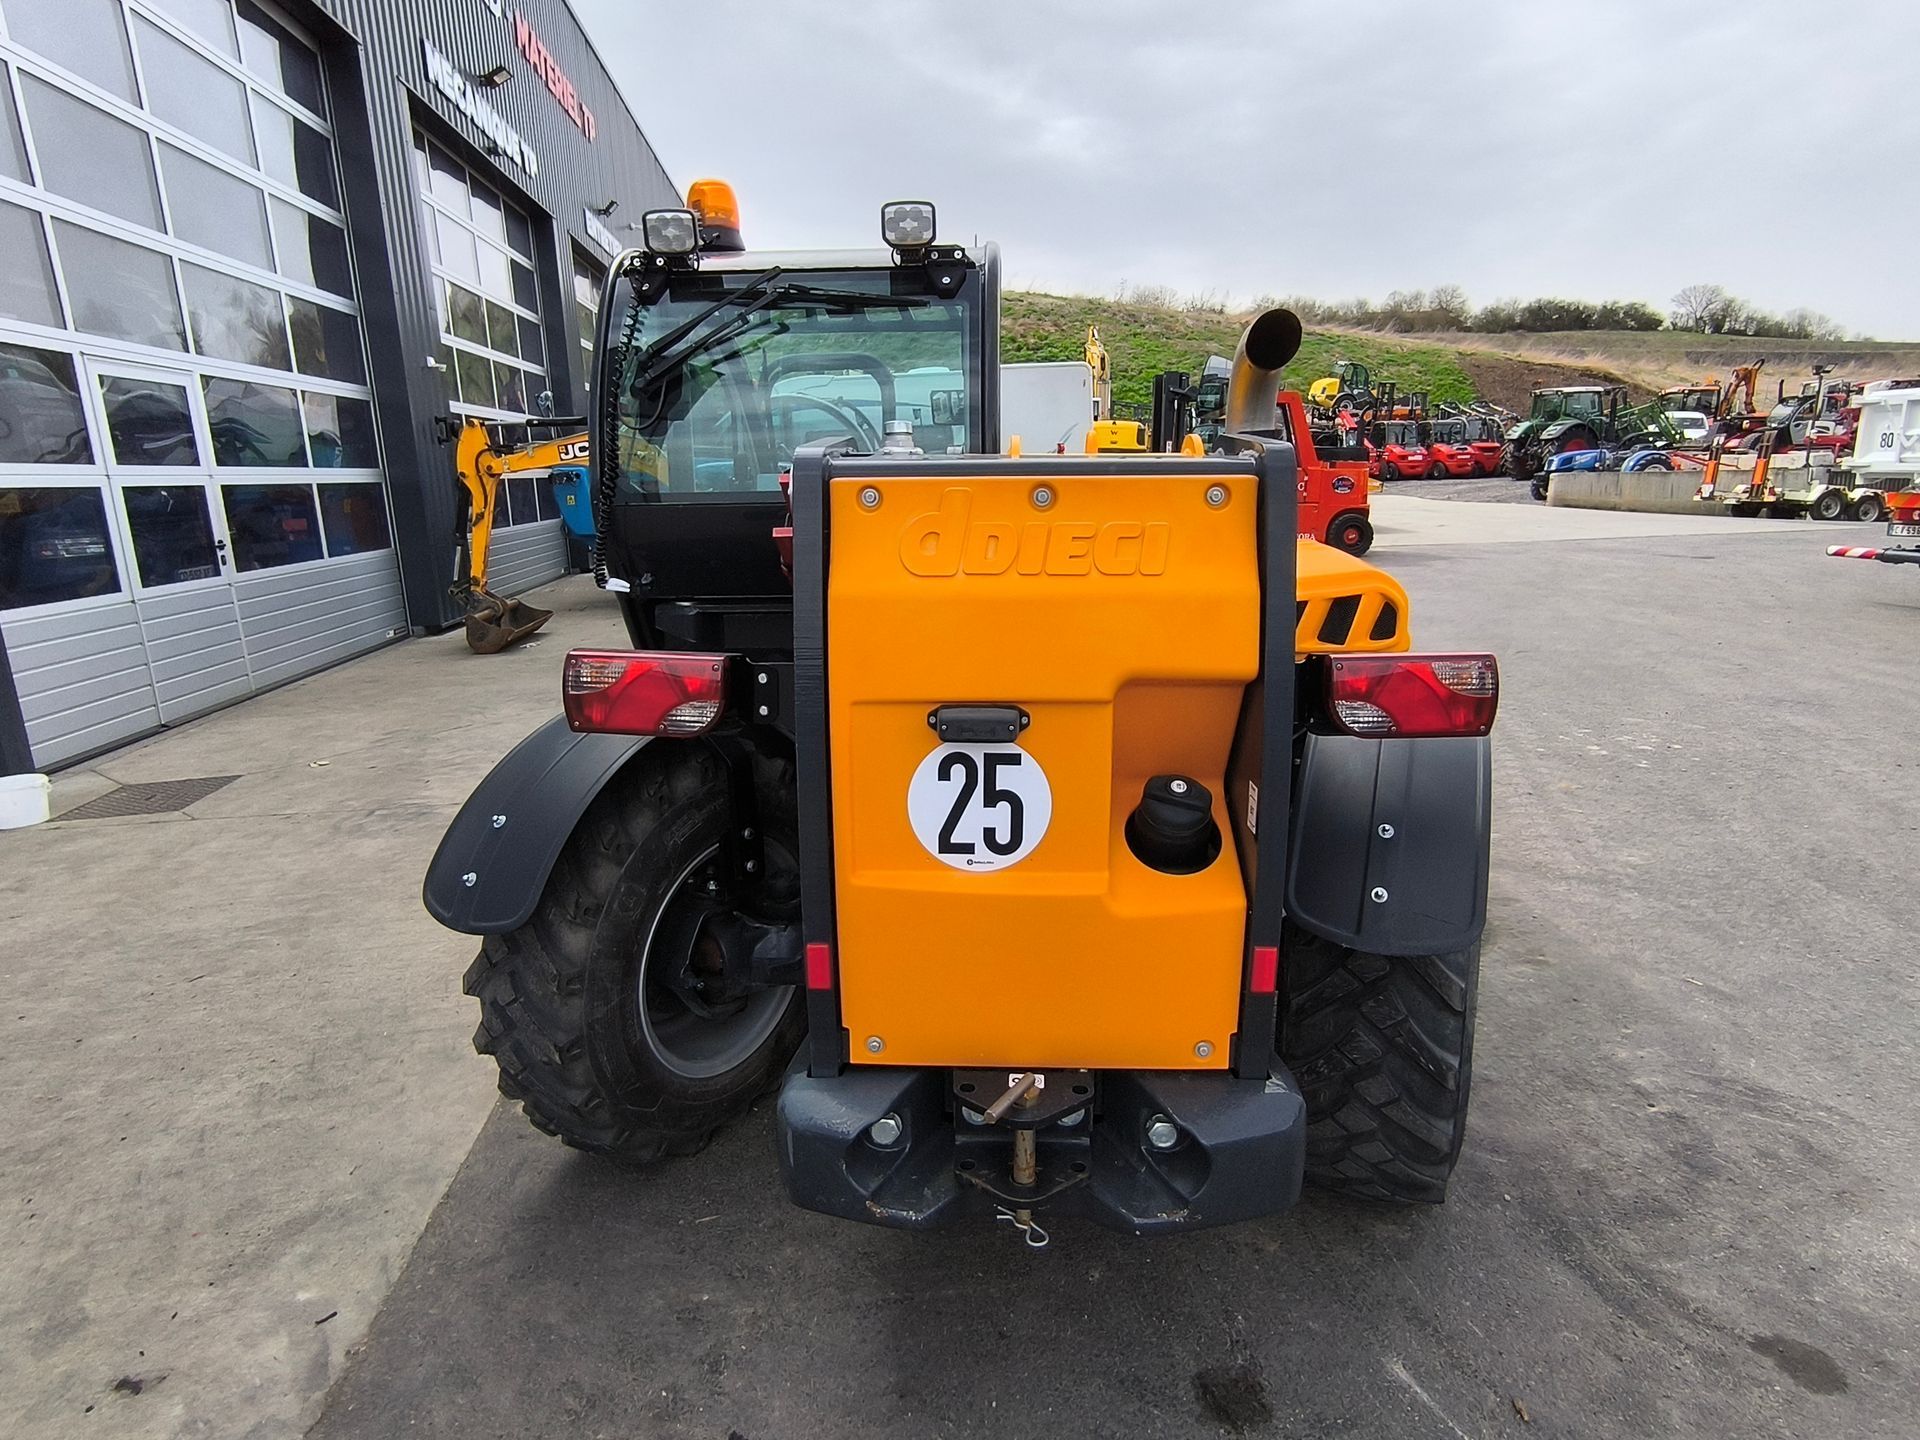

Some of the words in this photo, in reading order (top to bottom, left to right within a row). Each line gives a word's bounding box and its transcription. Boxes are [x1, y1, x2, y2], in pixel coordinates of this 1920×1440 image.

[421, 37, 522, 168] MECANIQUE
[520, 137, 538, 179] TP
[514, 8, 581, 129] MATERIEL
[581, 102, 597, 142] TP
[561, 441, 589, 460] JC
[1880, 432, 1894, 448] 80
[938, 751, 1024, 856] 25
